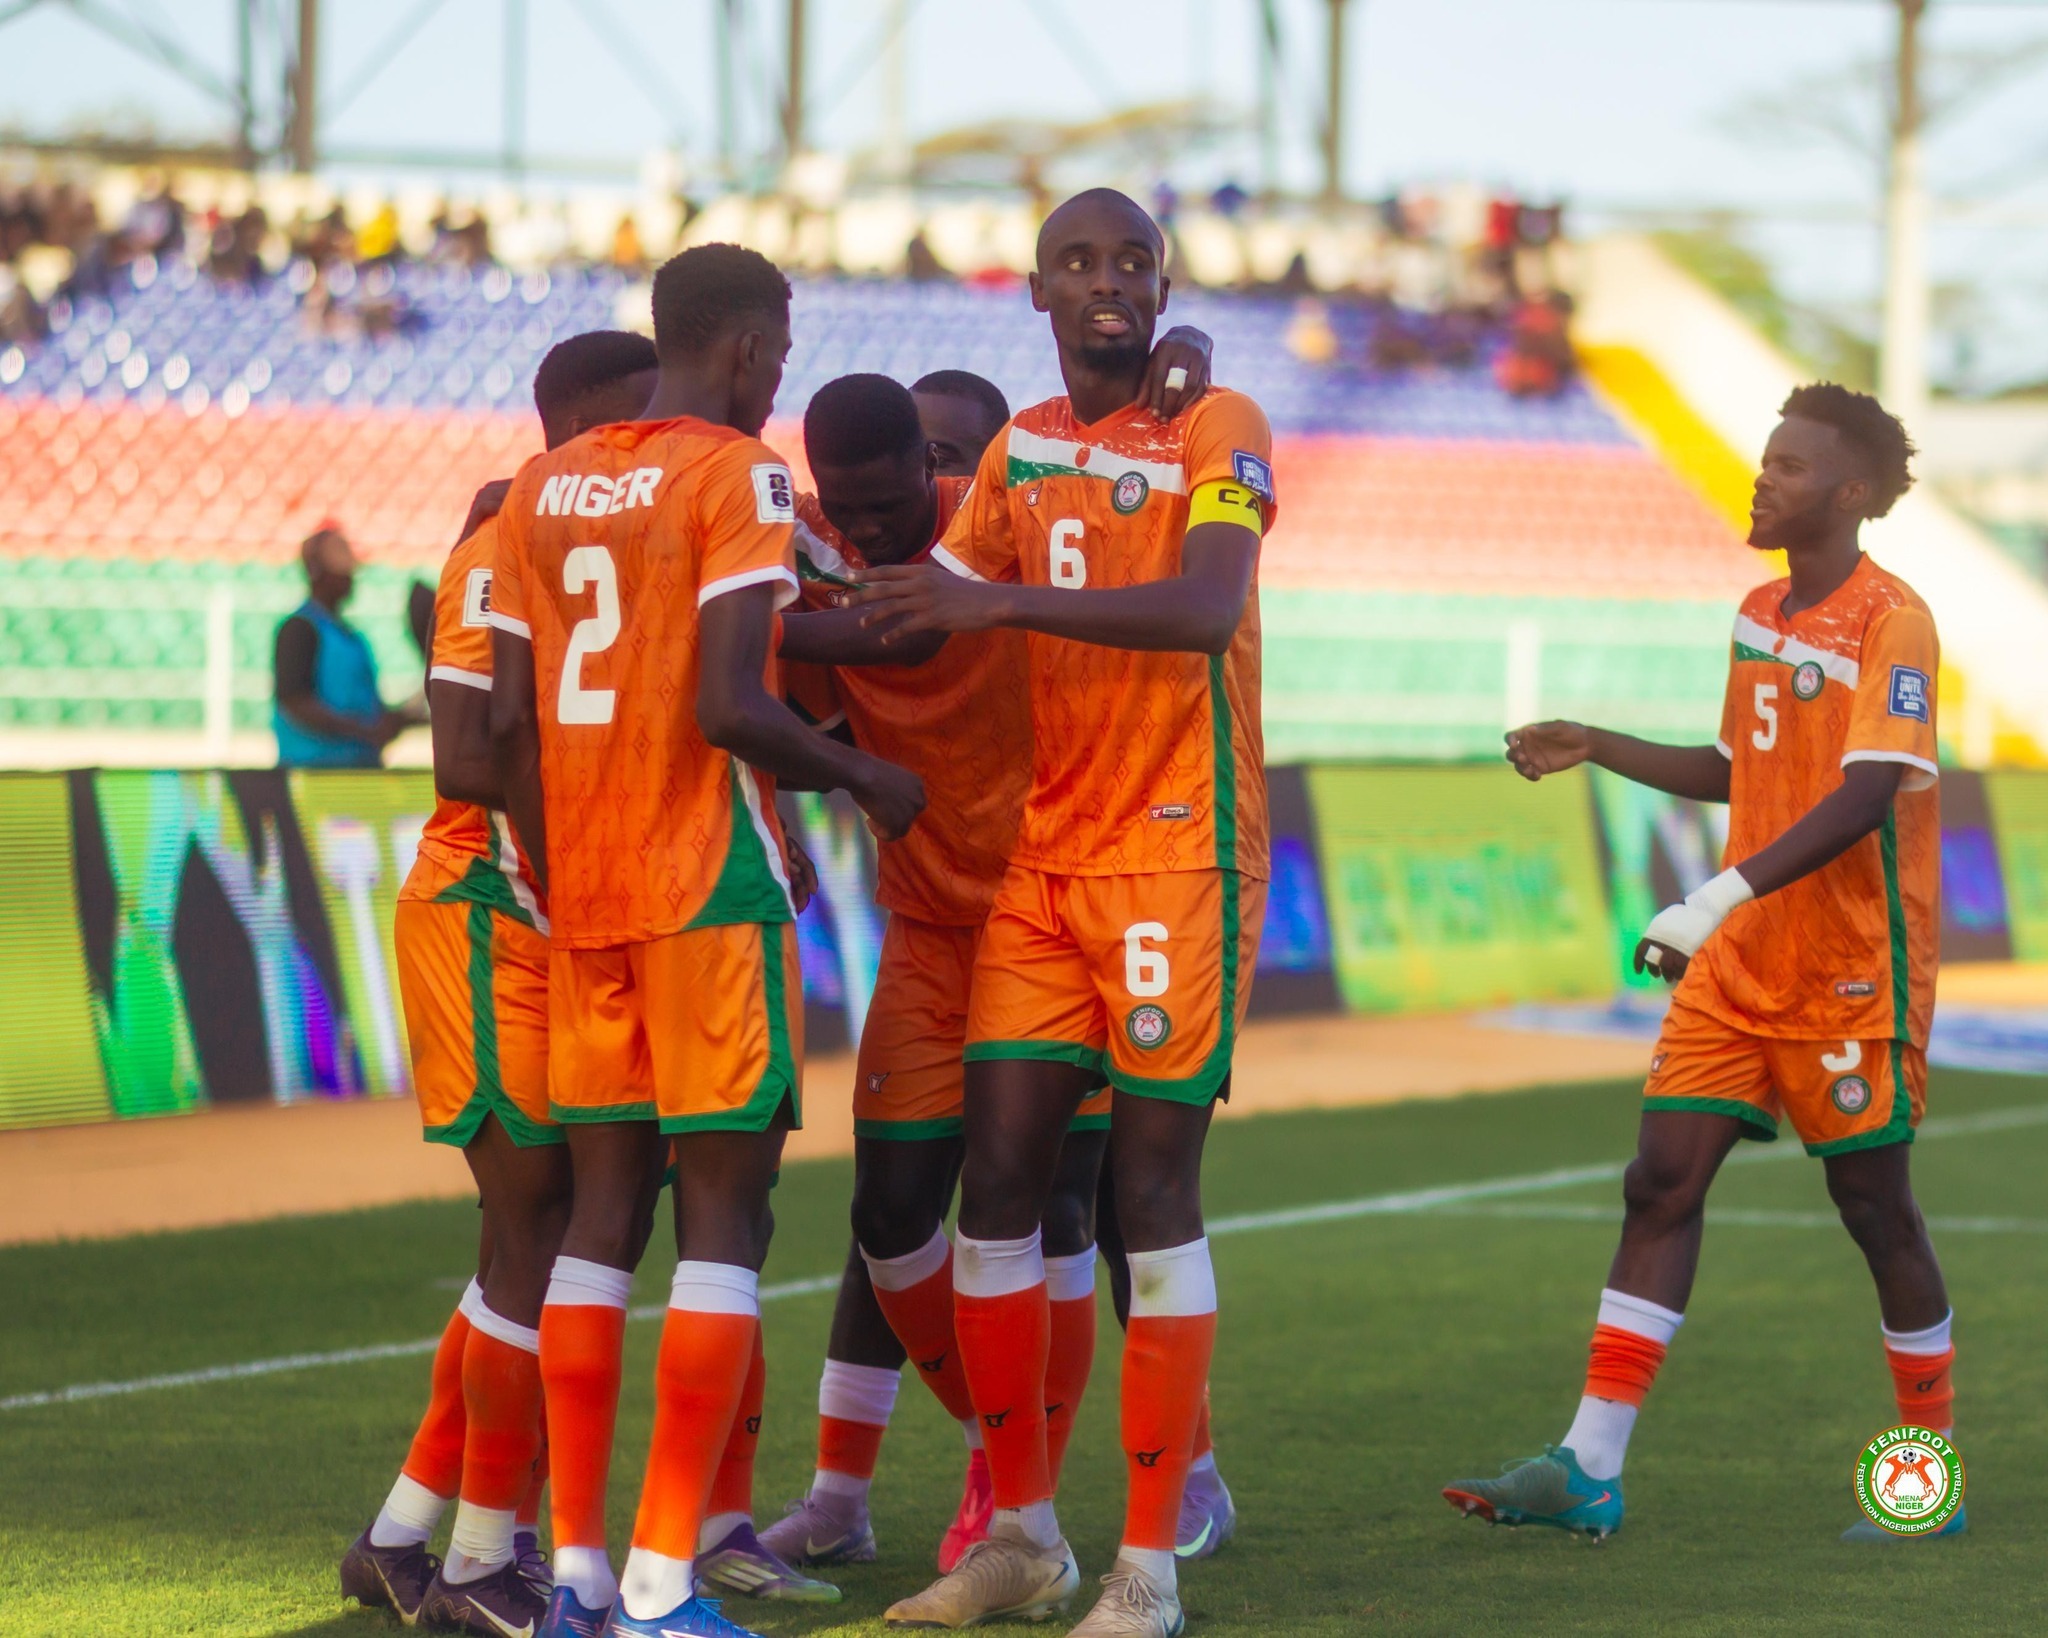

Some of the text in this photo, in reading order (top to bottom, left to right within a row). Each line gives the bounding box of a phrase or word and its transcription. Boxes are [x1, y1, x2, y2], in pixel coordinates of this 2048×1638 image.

[536, 467, 664, 517] NIGER
[1050, 519, 1087, 590] 6
[557, 545, 622, 725] 2
[1752, 683, 1778, 751] 5
[1124, 921, 1169, 997] 6
[1132, 1006, 1165, 1019] FENIFOOT
